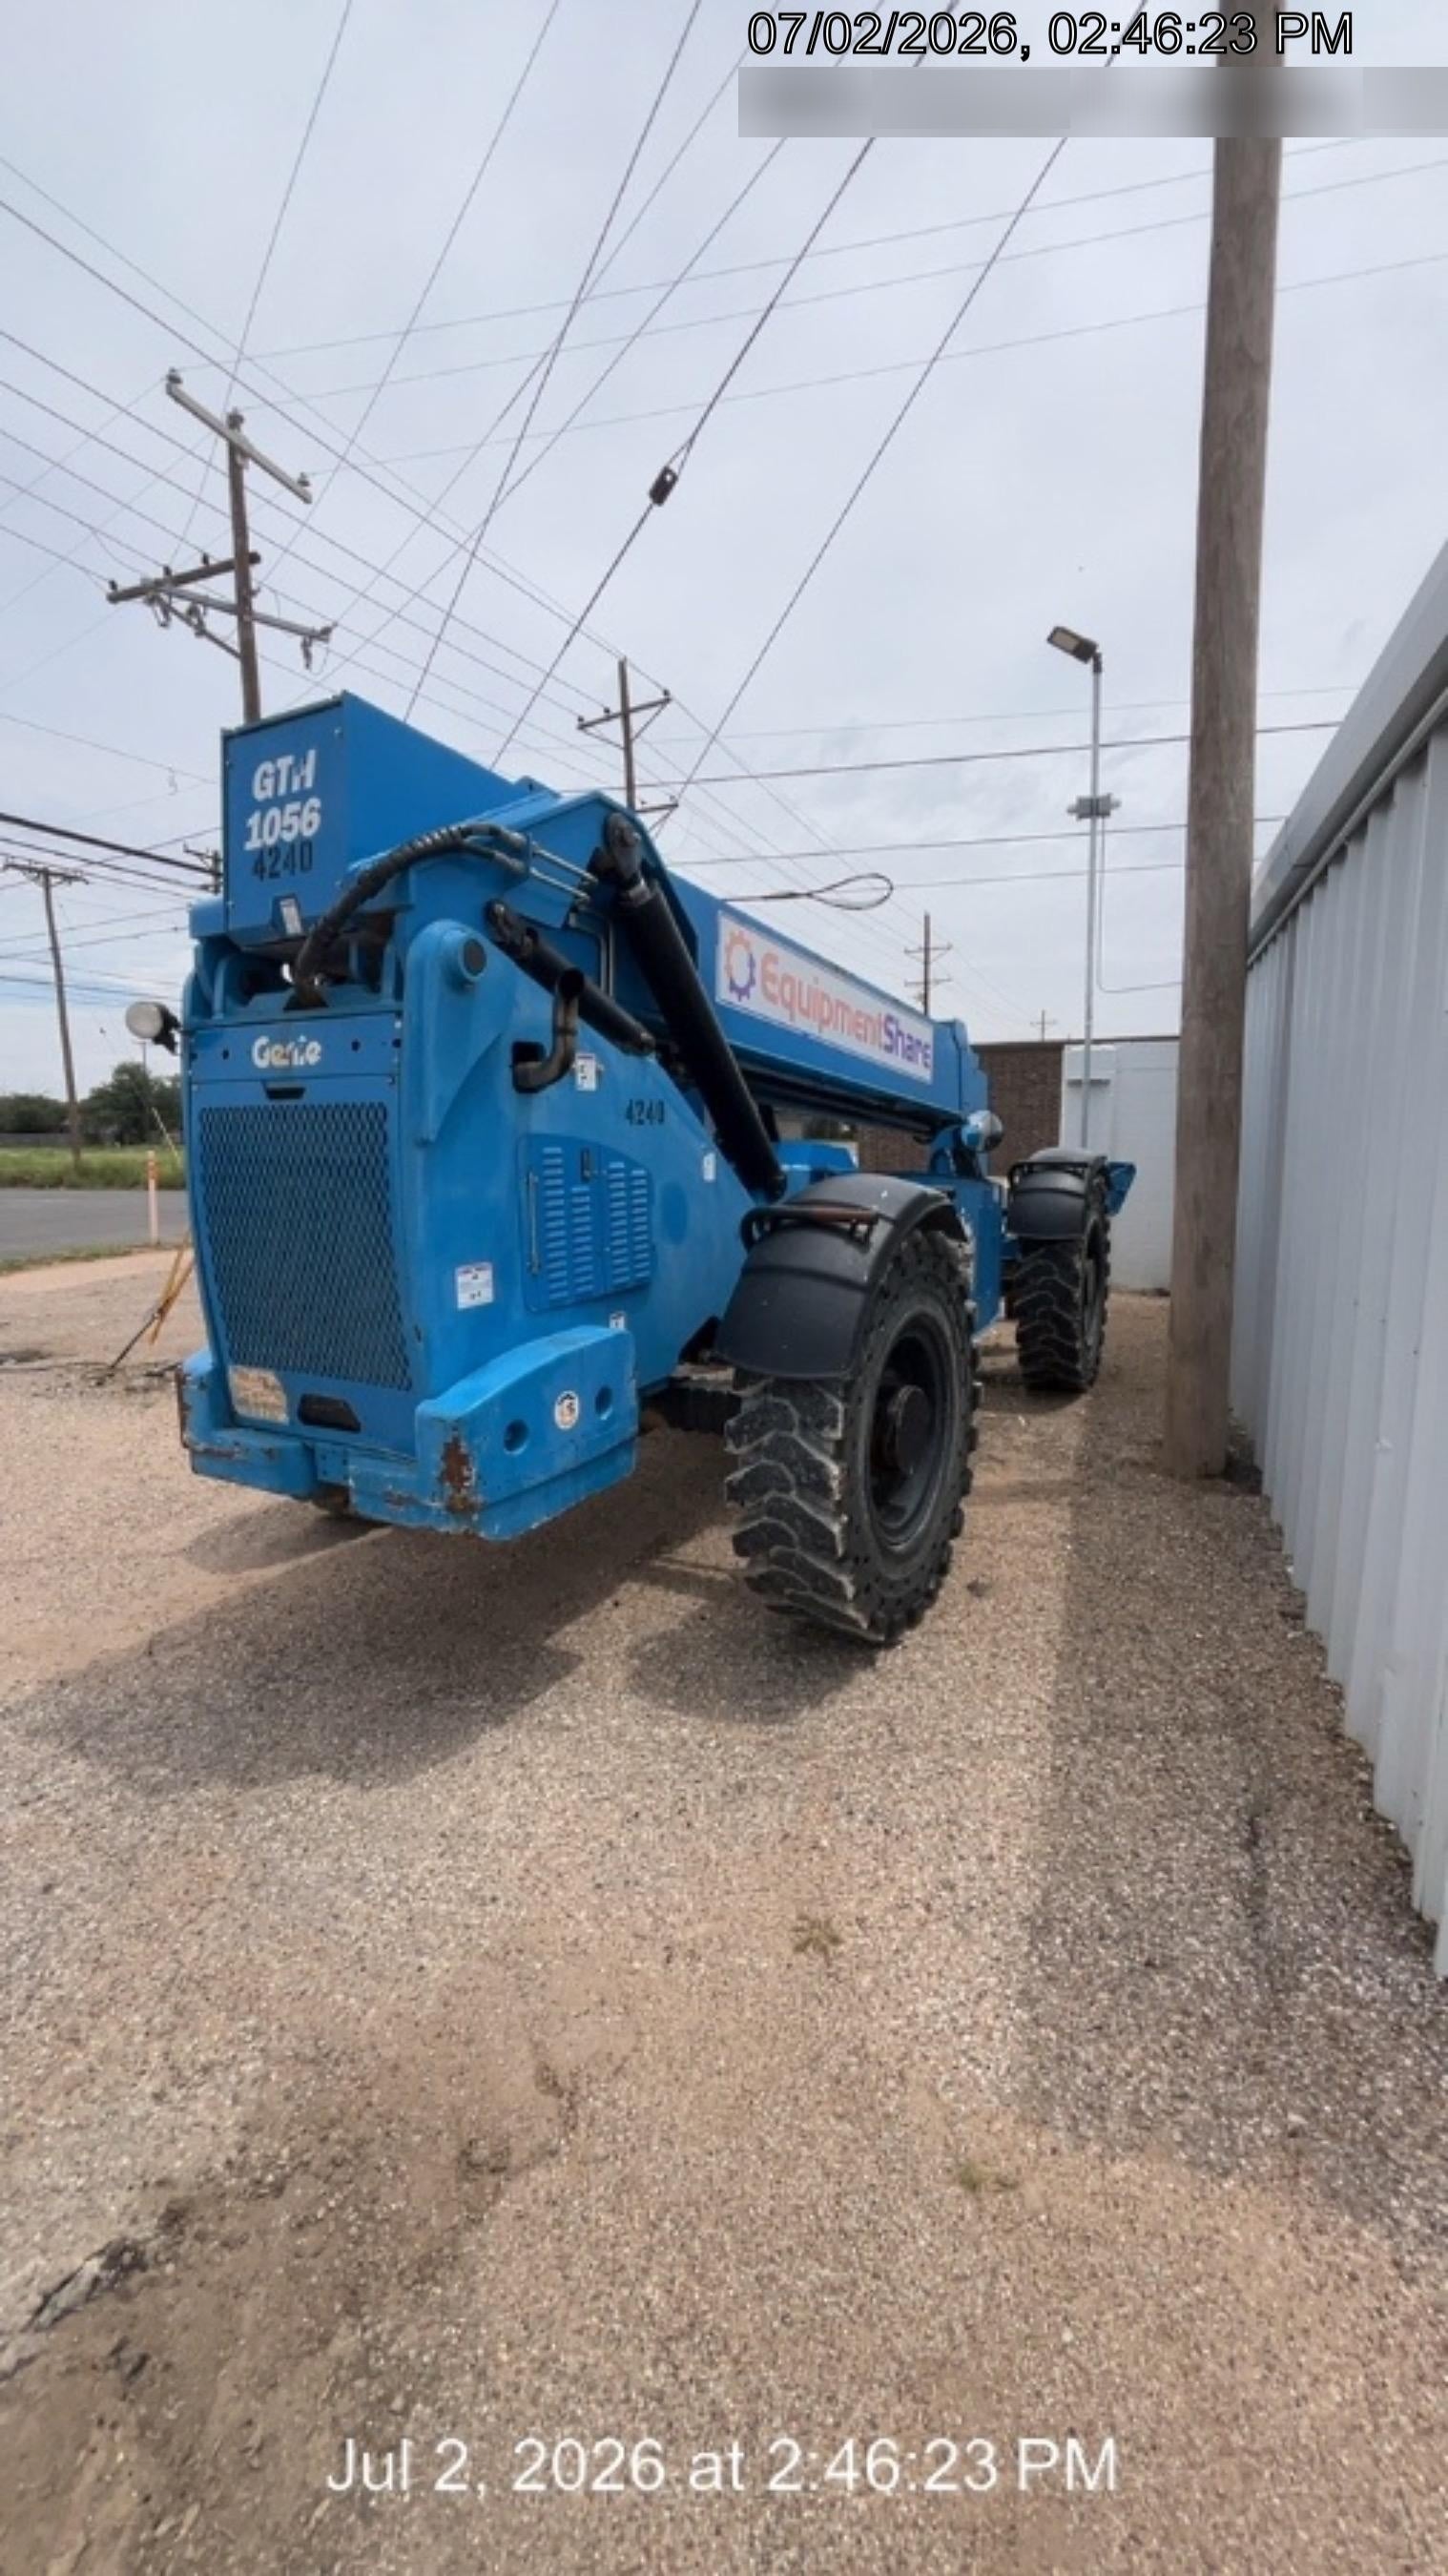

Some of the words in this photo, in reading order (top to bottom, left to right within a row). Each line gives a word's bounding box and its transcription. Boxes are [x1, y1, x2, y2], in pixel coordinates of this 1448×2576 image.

[252, 749, 316, 801] GTH
[244, 799, 321, 850] 1056
[252, 841, 313, 882] 4240
[760, 954, 931, 1068] EquipmentShare
[252, 1034, 321, 1069] Genie
[626, 1099, 665, 1126] 4240
